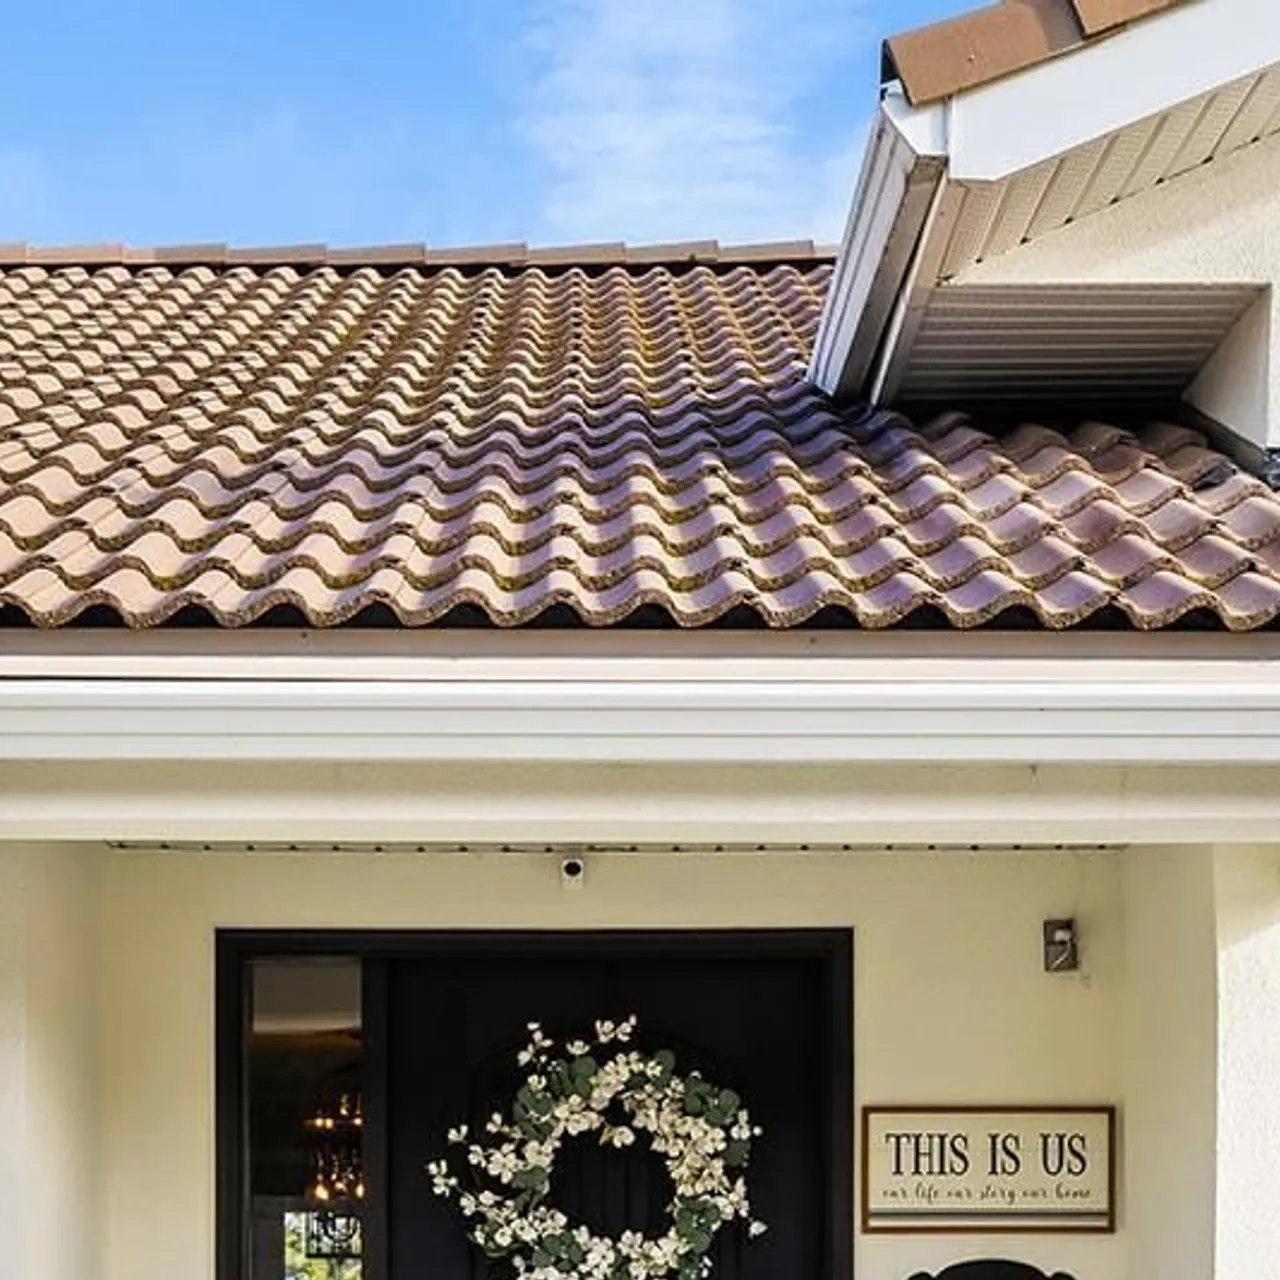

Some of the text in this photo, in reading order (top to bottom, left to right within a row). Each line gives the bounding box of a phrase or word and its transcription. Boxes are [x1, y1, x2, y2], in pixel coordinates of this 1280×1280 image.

[884, 1132, 1088, 1176] THIS IS US
[915, 1182, 939, 1204] life
[979, 1184, 1016, 1205] story
[1055, 1182, 1091, 1199] home
